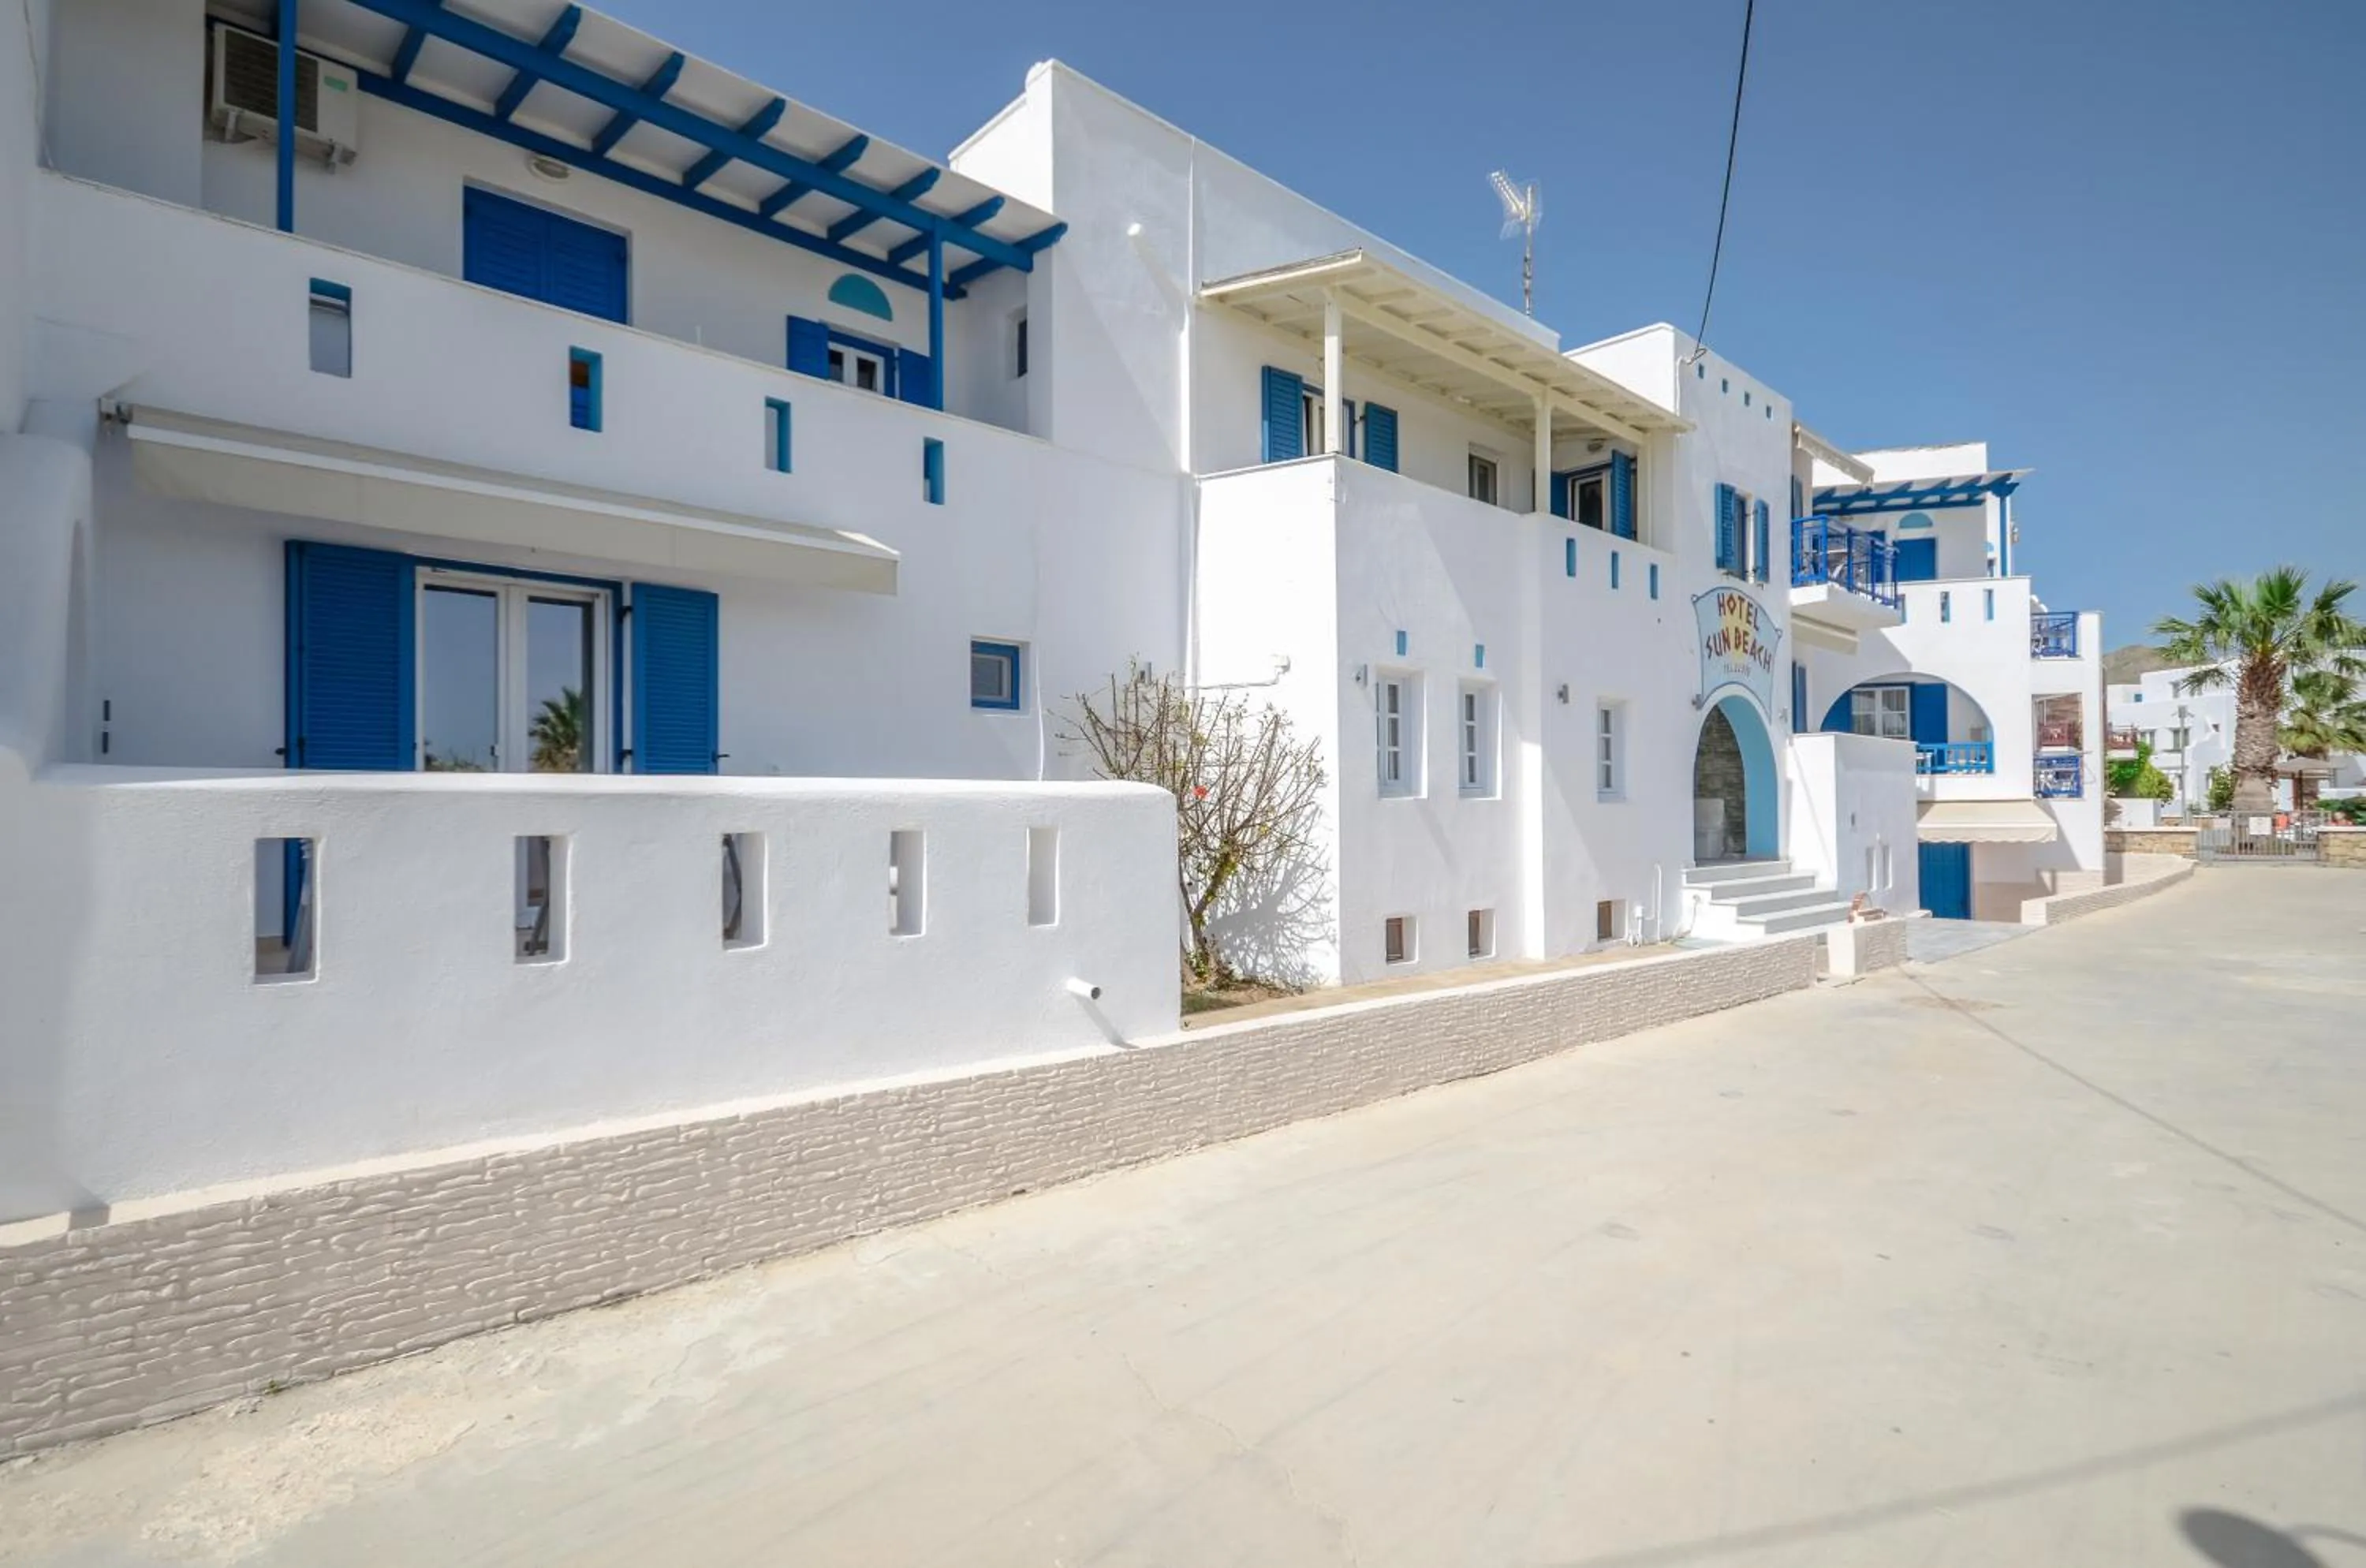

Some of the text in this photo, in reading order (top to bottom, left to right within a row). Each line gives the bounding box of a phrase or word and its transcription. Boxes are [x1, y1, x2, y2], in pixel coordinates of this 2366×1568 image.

[1717, 592, 1760, 632] HOTEL
[1705, 626, 1732, 659] SUN
[1734, 626, 1772, 674] BEACH
